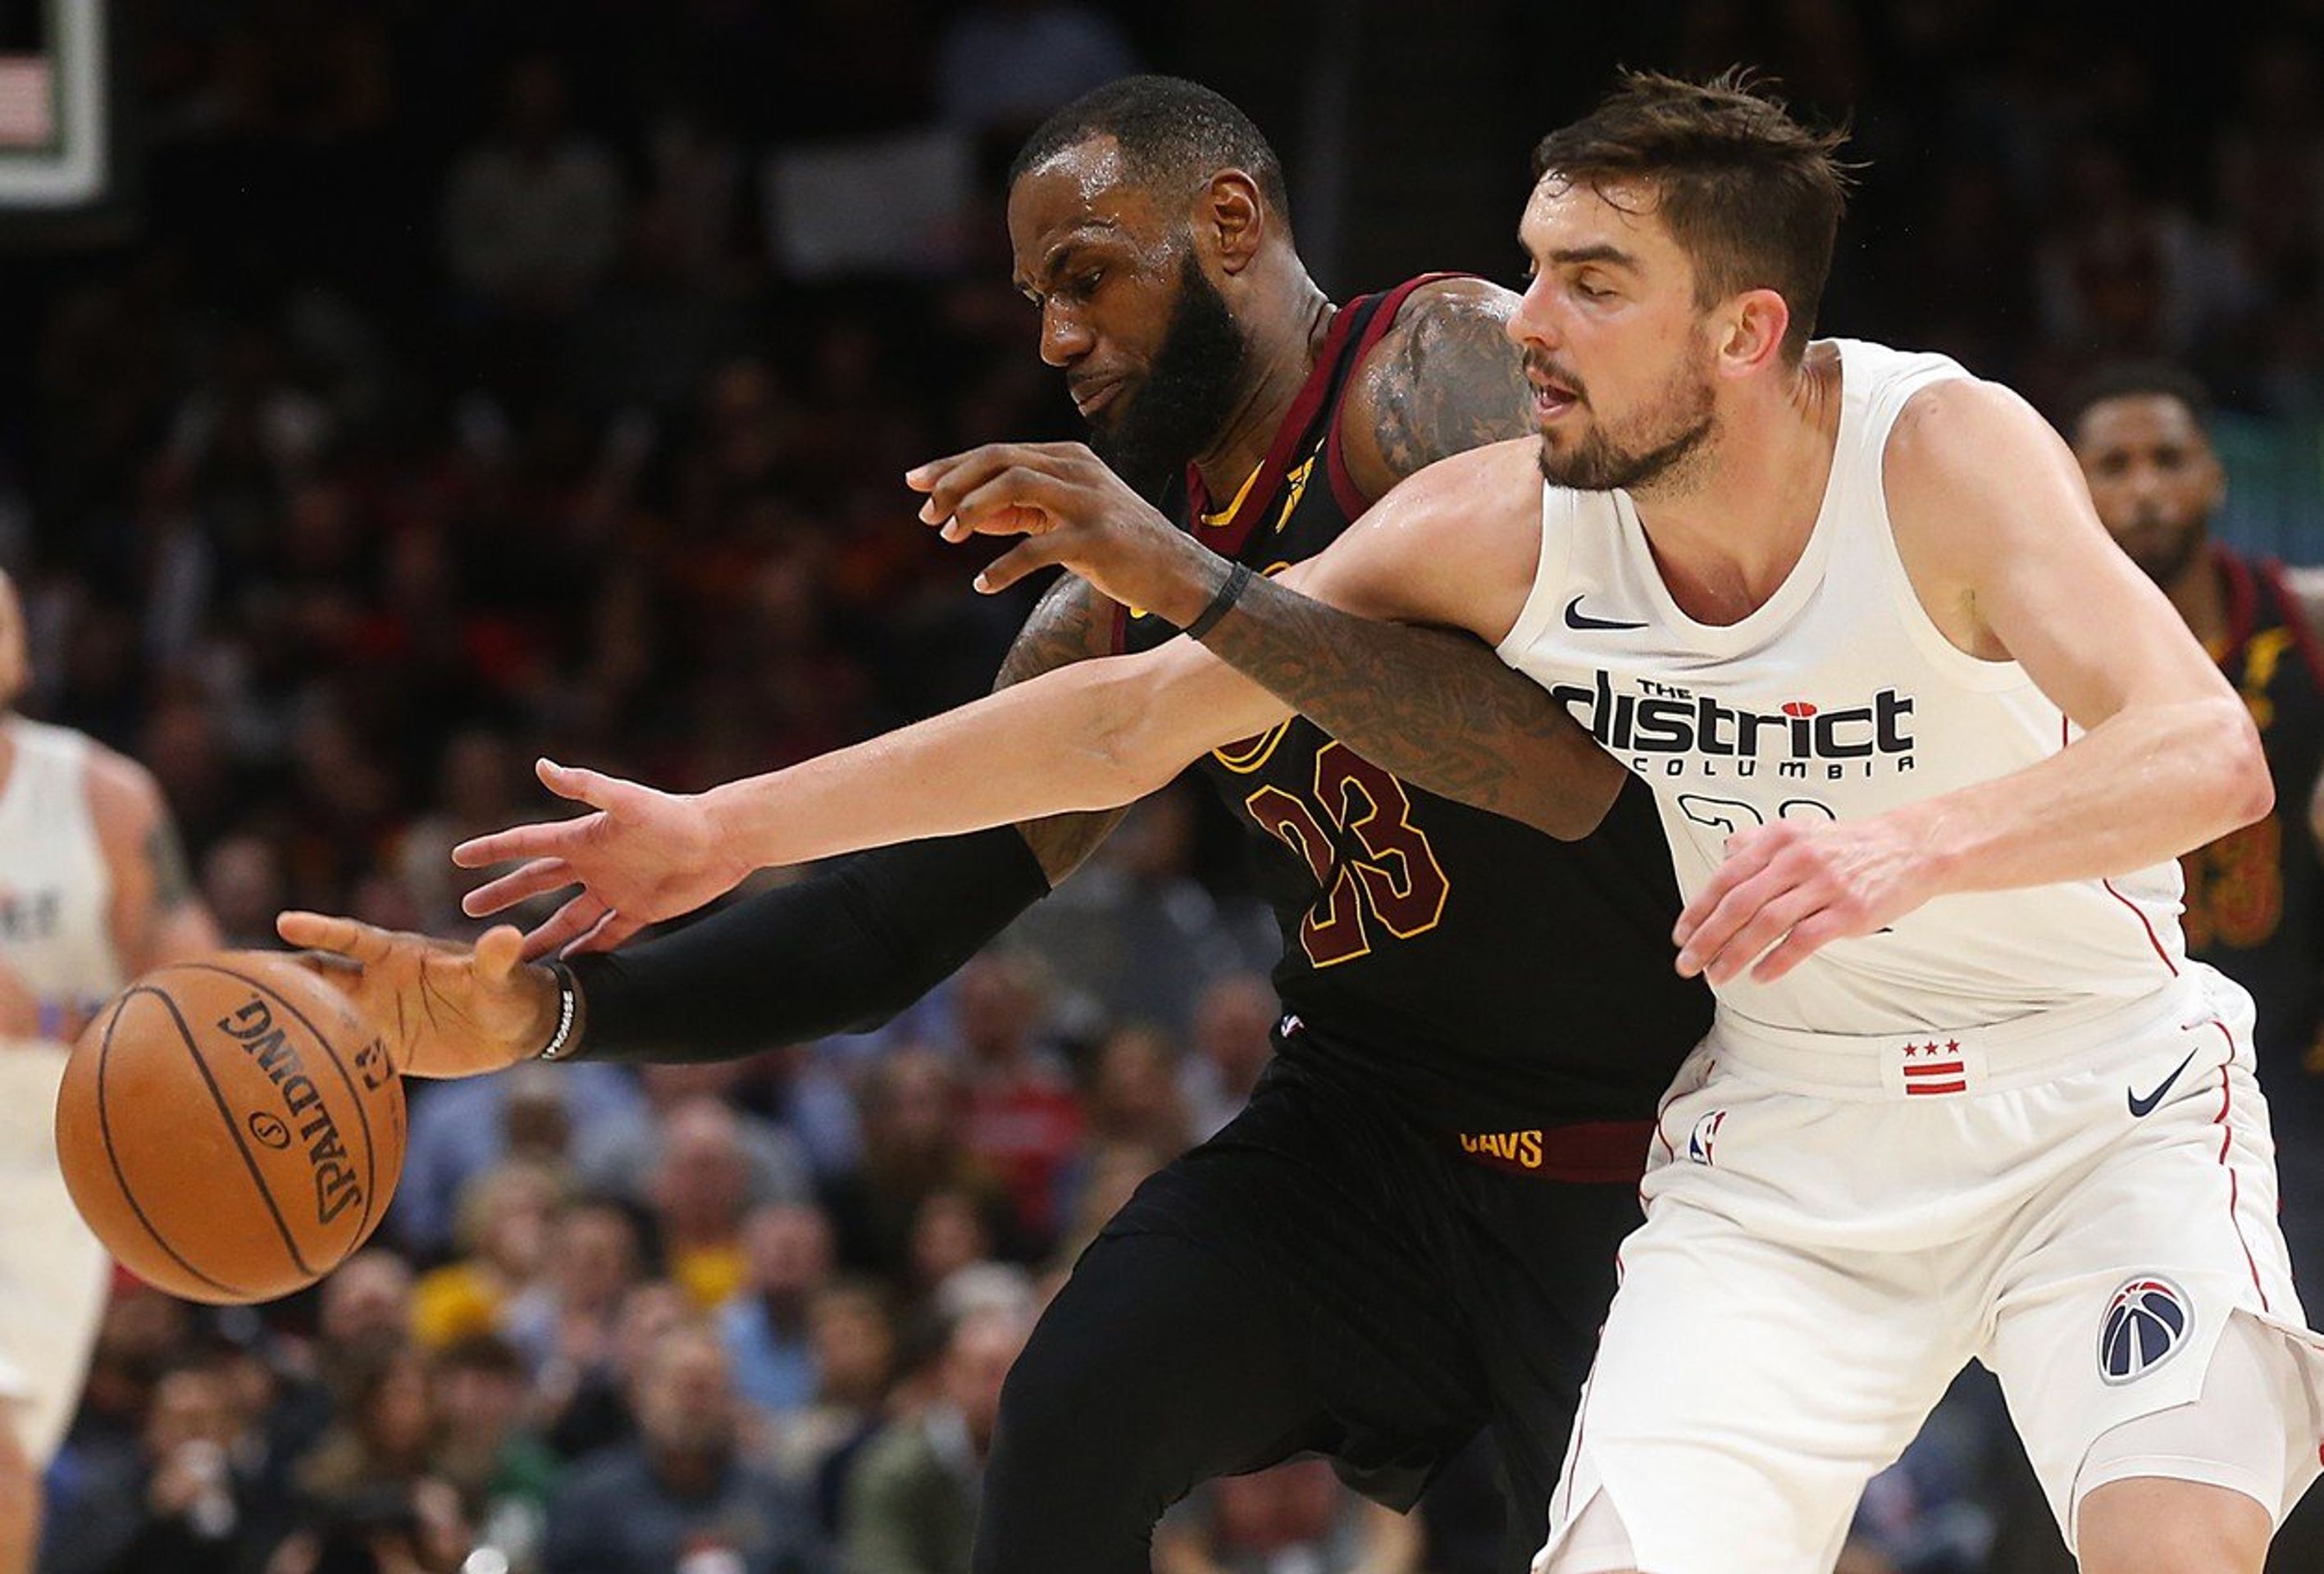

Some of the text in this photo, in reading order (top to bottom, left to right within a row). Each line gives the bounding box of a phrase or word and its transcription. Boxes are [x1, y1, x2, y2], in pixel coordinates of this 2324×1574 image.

[1552, 669, 1914, 759] district
[1636, 678, 1693, 700] THE
[1632, 756, 1914, 780] COLUMBIA
[1245, 739, 1450, 969] 23
[216, 999, 362, 1225] SPALDING
[1460, 1130, 1542, 1169] CAVS
